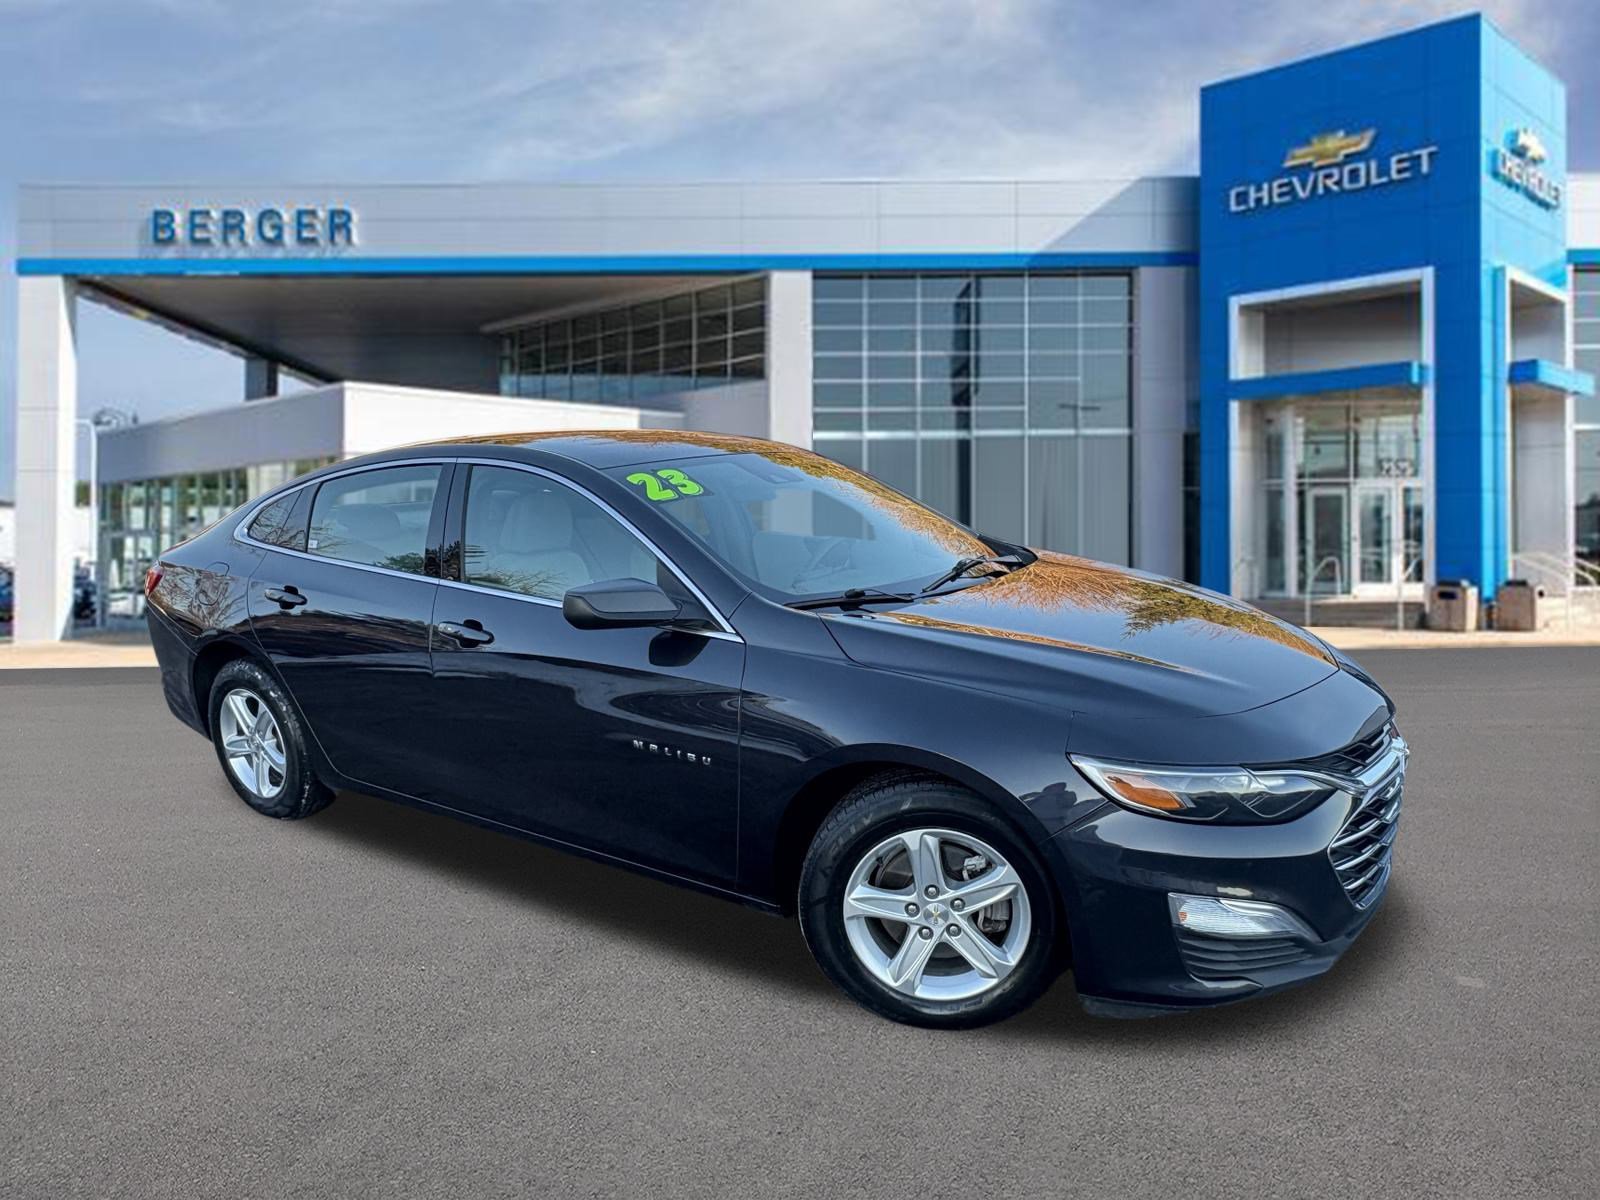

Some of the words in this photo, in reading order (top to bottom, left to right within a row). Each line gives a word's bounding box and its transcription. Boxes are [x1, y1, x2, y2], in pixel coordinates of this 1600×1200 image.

[1229, 146, 1438, 212] CHEVROLET
[151, 208, 354, 245] BERGER
[626, 468, 704, 501] 23
[633, 739, 711, 766] MALIBU
